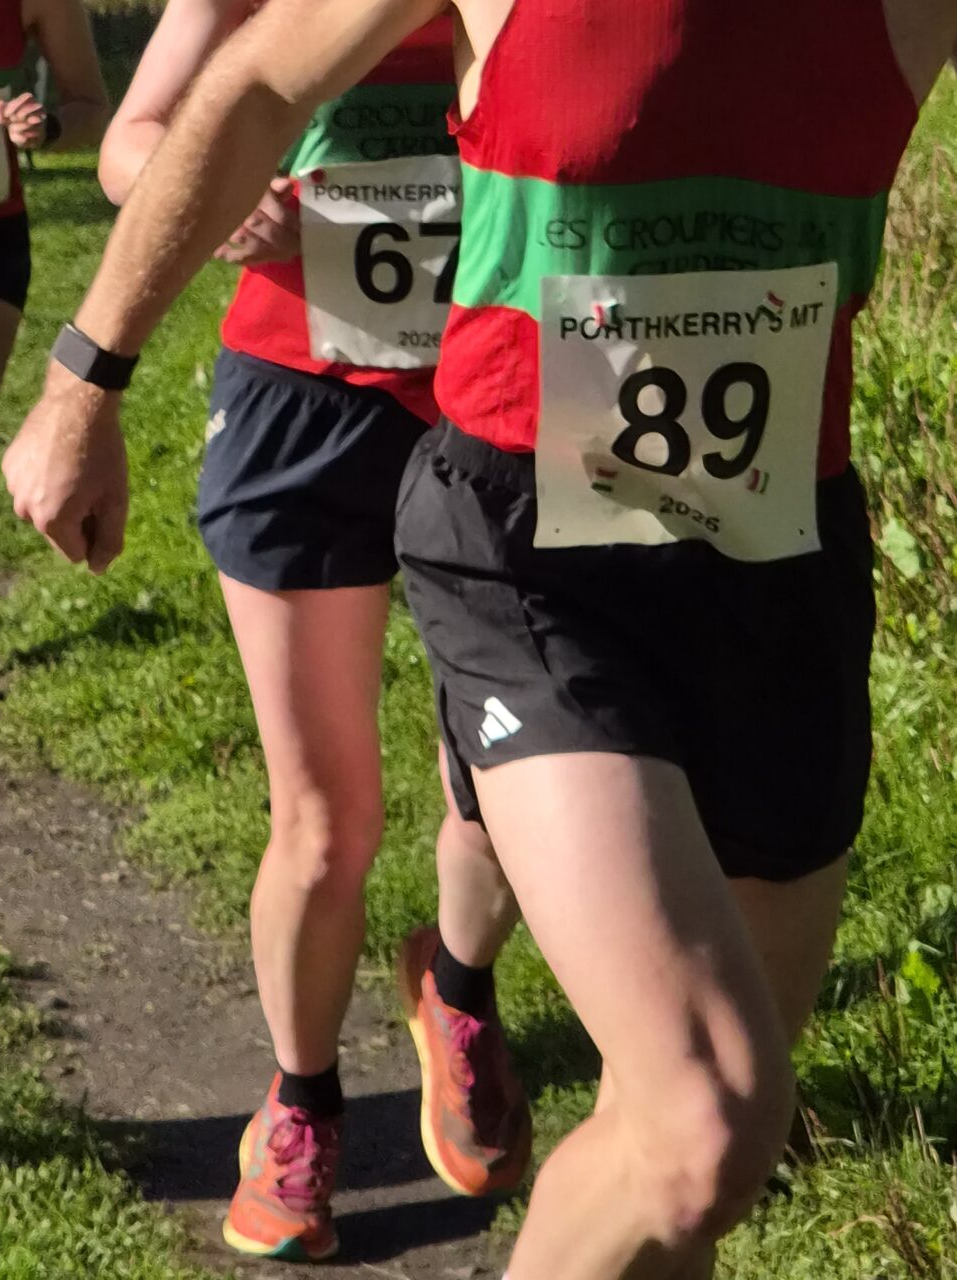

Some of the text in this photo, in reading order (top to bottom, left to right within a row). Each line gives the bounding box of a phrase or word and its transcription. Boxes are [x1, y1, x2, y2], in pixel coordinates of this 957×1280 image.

[354, 222, 462, 304] 67
[789, 302, 824, 328] MT
[611, 361, 771, 480] 89
[659, 494, 721, 534] 2026
